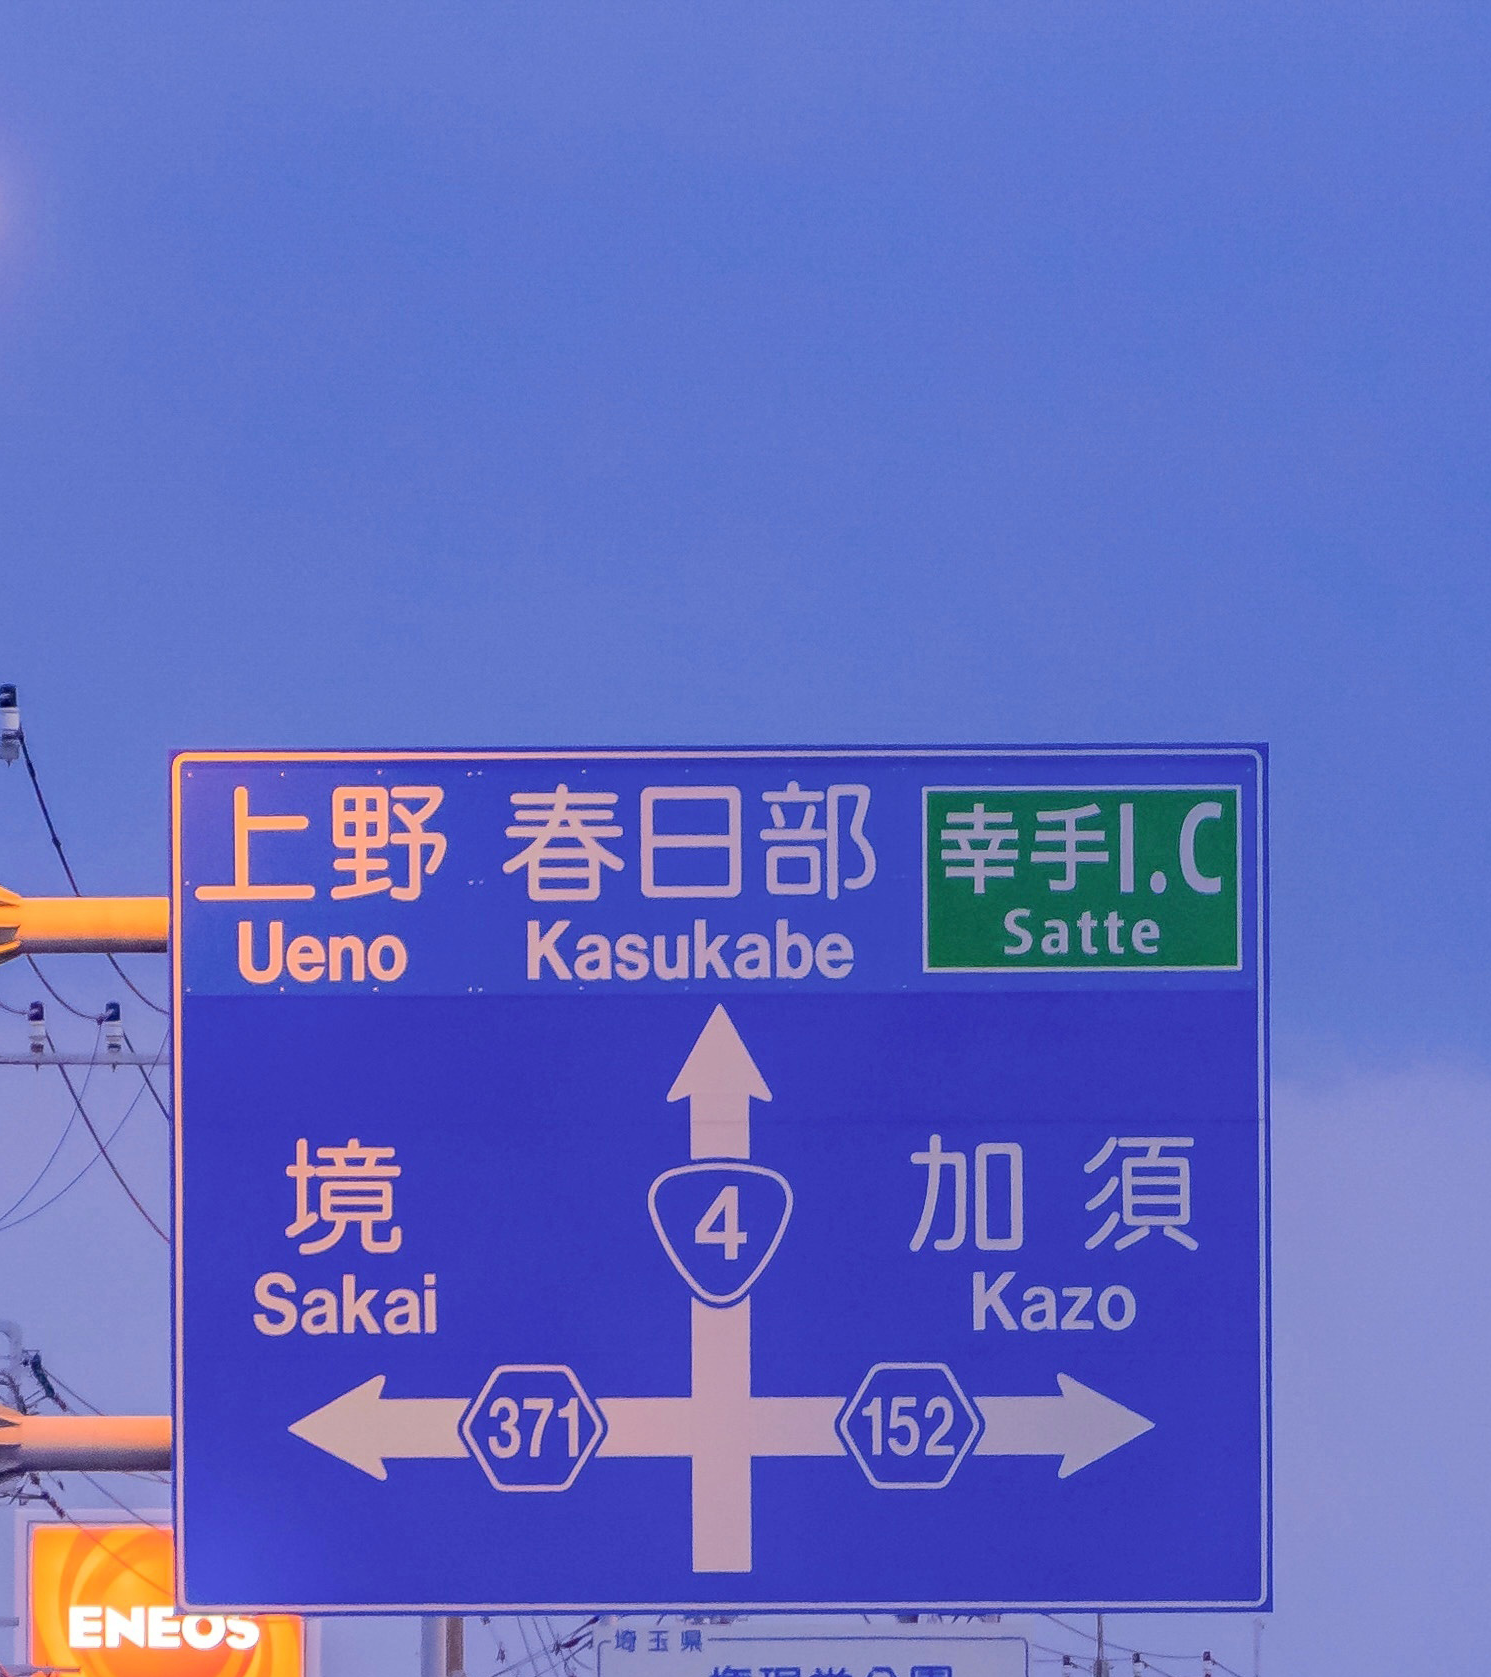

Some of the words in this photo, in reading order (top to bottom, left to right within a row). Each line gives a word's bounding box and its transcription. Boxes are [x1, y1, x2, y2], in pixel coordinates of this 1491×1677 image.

[195, 784, 447, 902] 上野
[502, 782, 878, 902] 春日部
[236, 919, 408, 983] Ueno
[523, 917, 856, 981] Kasukabe
[1001, 908, 1162, 958] Satte
[285, 1136, 403, 1255] 境
[908, 1134, 1201, 1251] 加須
[694, 1185, 748, 1263] 4
[252, 1271, 439, 1336] Sakai
[971, 1270, 1138, 1331] Kazo
[487, 1397, 583, 1459] 371
[859, 1395, 955, 1457] 152
[68, 1605, 260, 1650] ENEOS
[615, 1629, 705, 1653] 埼玉県
